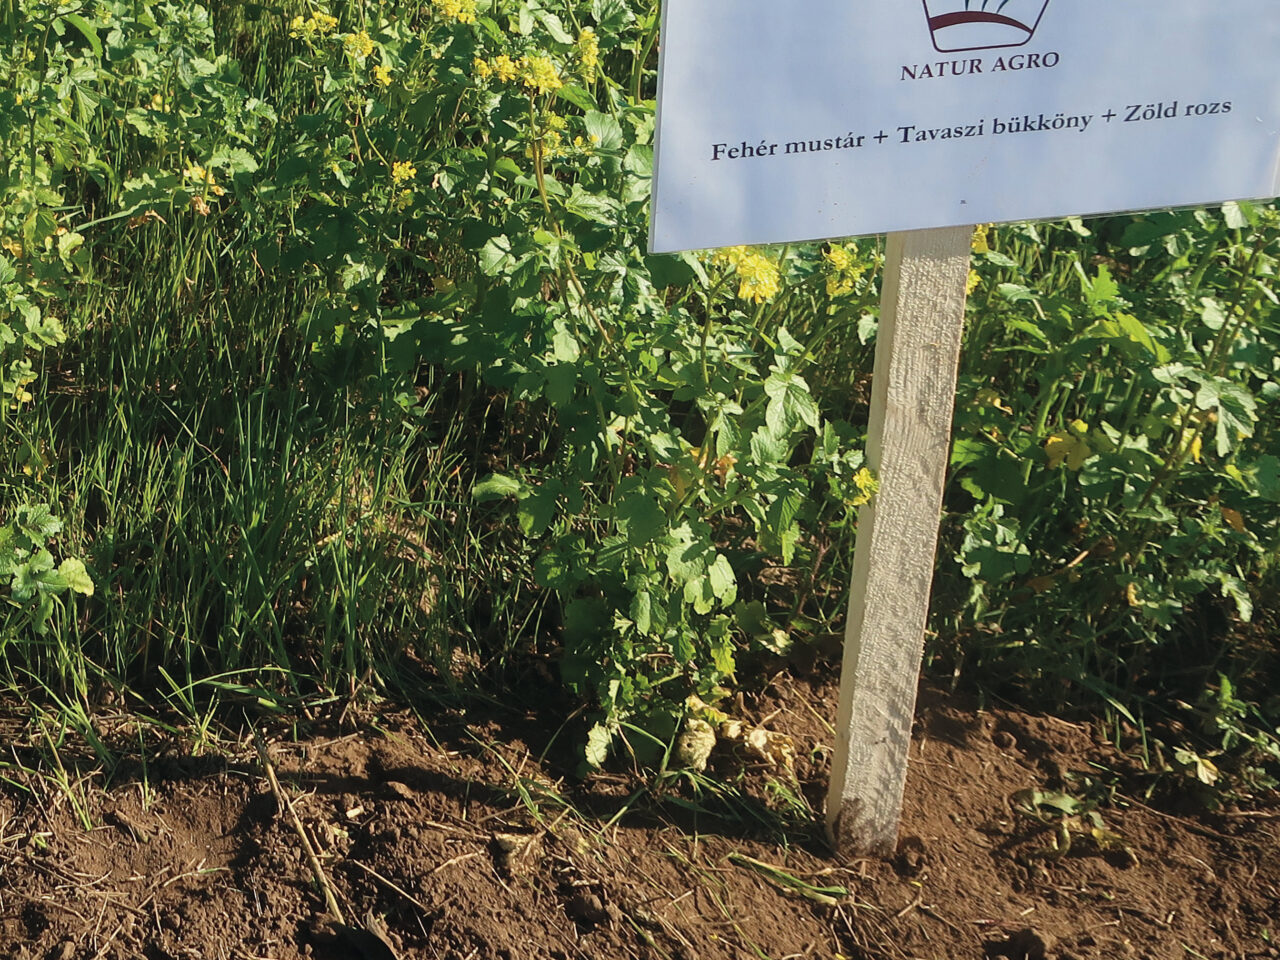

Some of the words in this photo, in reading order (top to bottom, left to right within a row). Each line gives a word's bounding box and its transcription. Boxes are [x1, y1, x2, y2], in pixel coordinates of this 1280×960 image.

[900, 58, 983, 81] NATUR
[990, 51, 1060, 72] AGRO
[711, 139, 778, 161] Fehér
[784, 132, 866, 154] mustár
[896, 119, 985, 143] Tavaszi
[991, 113, 1094, 135] bükköny
[1123, 100, 1178, 122] Zöld
[1184, 100, 1232, 117] rozs
